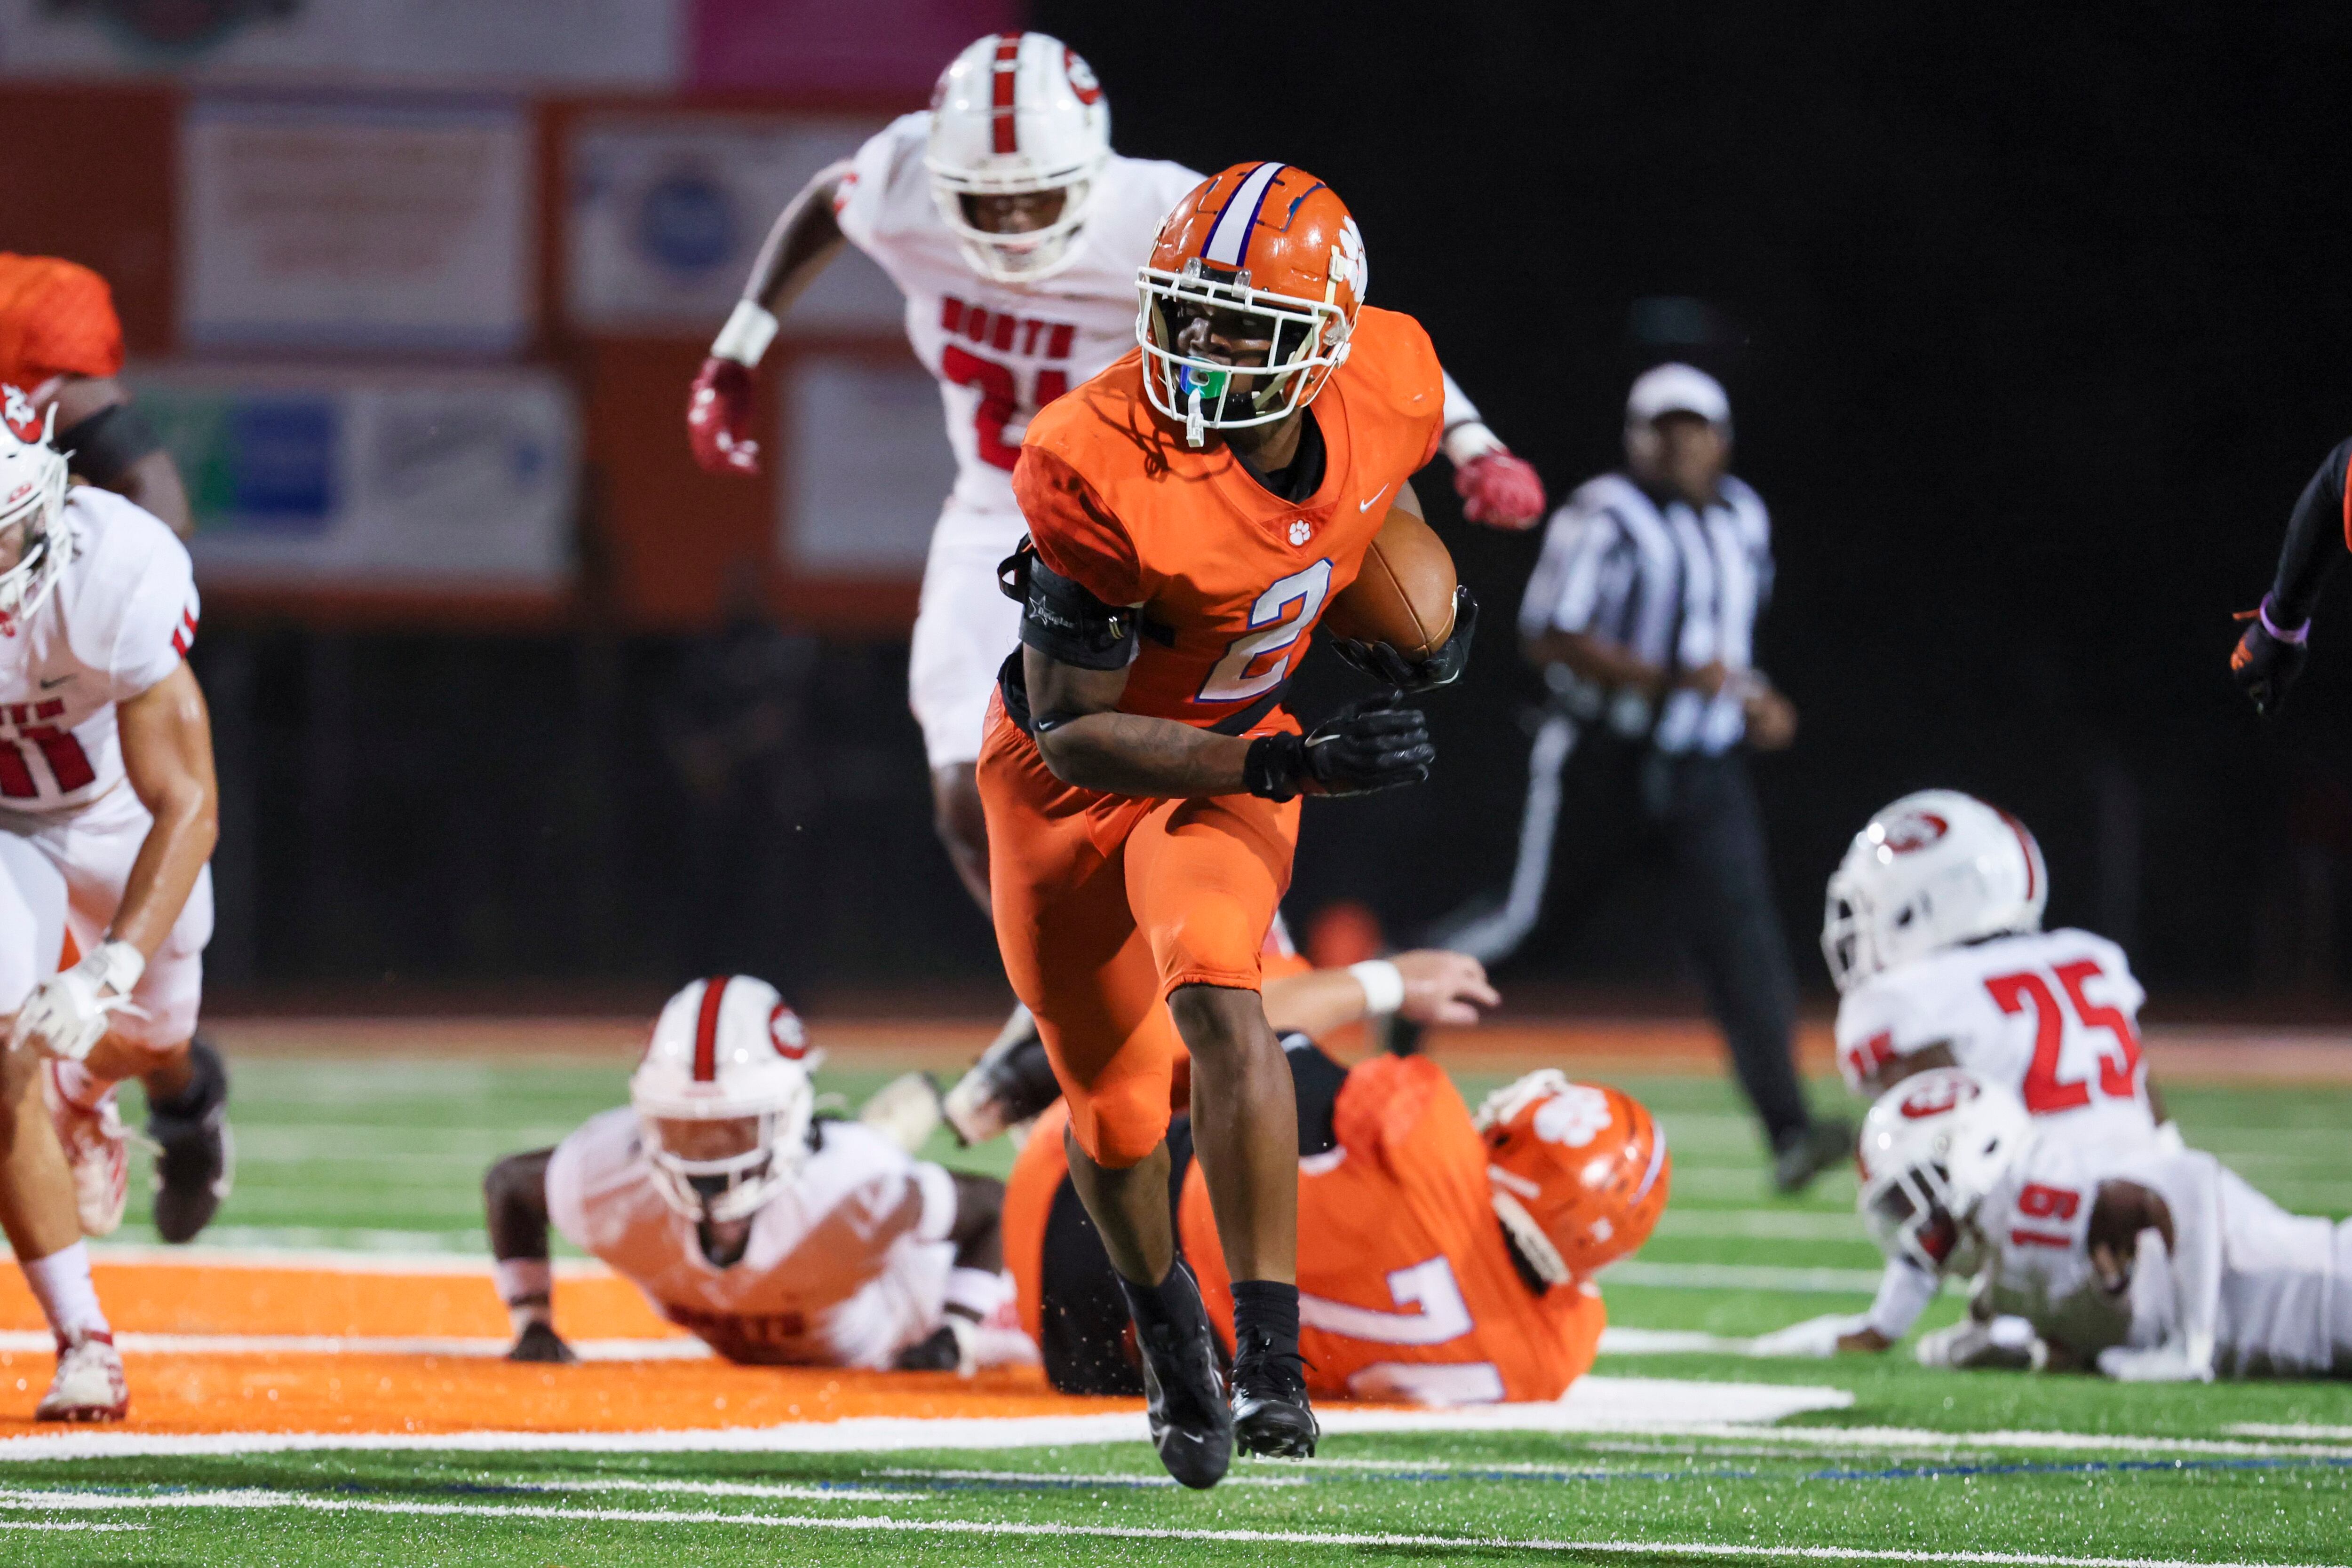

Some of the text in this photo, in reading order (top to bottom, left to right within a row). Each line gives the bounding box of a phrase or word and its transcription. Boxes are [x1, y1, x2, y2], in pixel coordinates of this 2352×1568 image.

[942, 343, 1070, 472] 2
[1194, 557, 1335, 703] 2
[1983, 958, 2143, 1116] 25
[2011, 1181, 2080, 1249] 19
